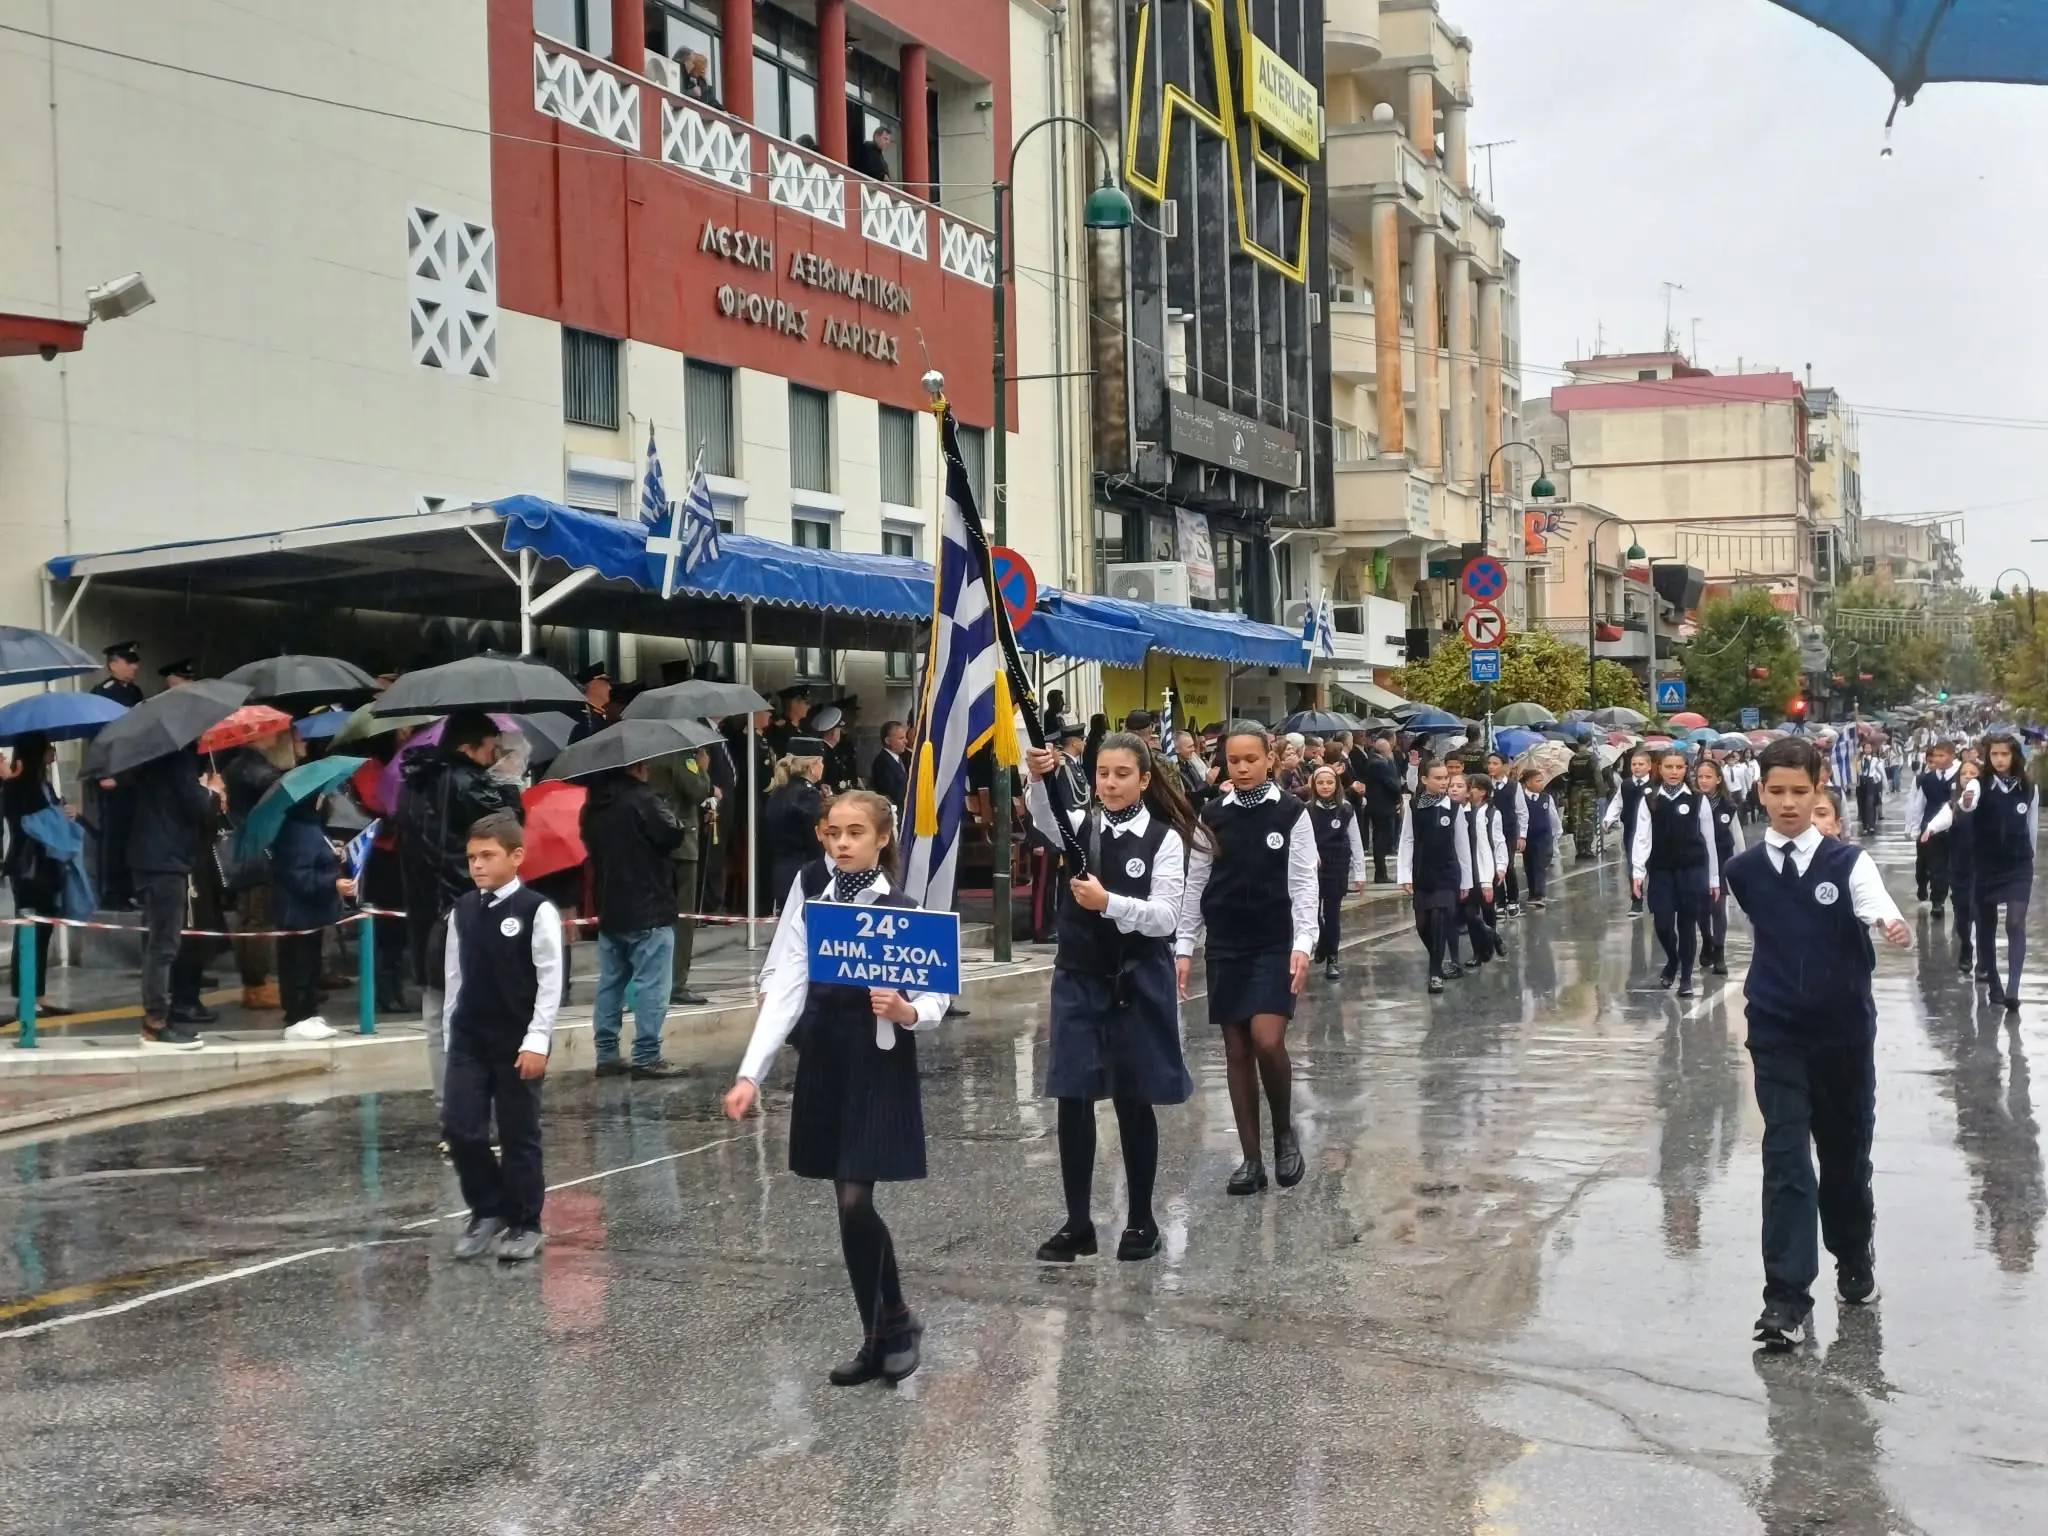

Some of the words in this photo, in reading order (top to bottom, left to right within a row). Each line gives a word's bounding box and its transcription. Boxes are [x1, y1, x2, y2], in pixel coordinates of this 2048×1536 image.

[1259, 54, 1313, 126] ALTERLIFE
[702, 217, 774, 272] ΛΕΣΧΗ
[790, 249, 912, 316] ΑΞΙΩΜΑΤΙΚΩΝ
[717, 283, 810, 342] ΦΡΟΥΡΑΣ
[823, 314, 901, 366] ΛΑΡΙΣΑΣ
[1269, 834, 1281, 846] 24
[1128, 860, 1143, 875] 24
[1819, 886, 1834, 901] 24
[818, 939, 873, 960] ΔΗΜ.
[883, 944, 948, 967] ΣΧΟΛ.
[837, 962, 929, 986] ΛΑΡΙΣΑΣ
